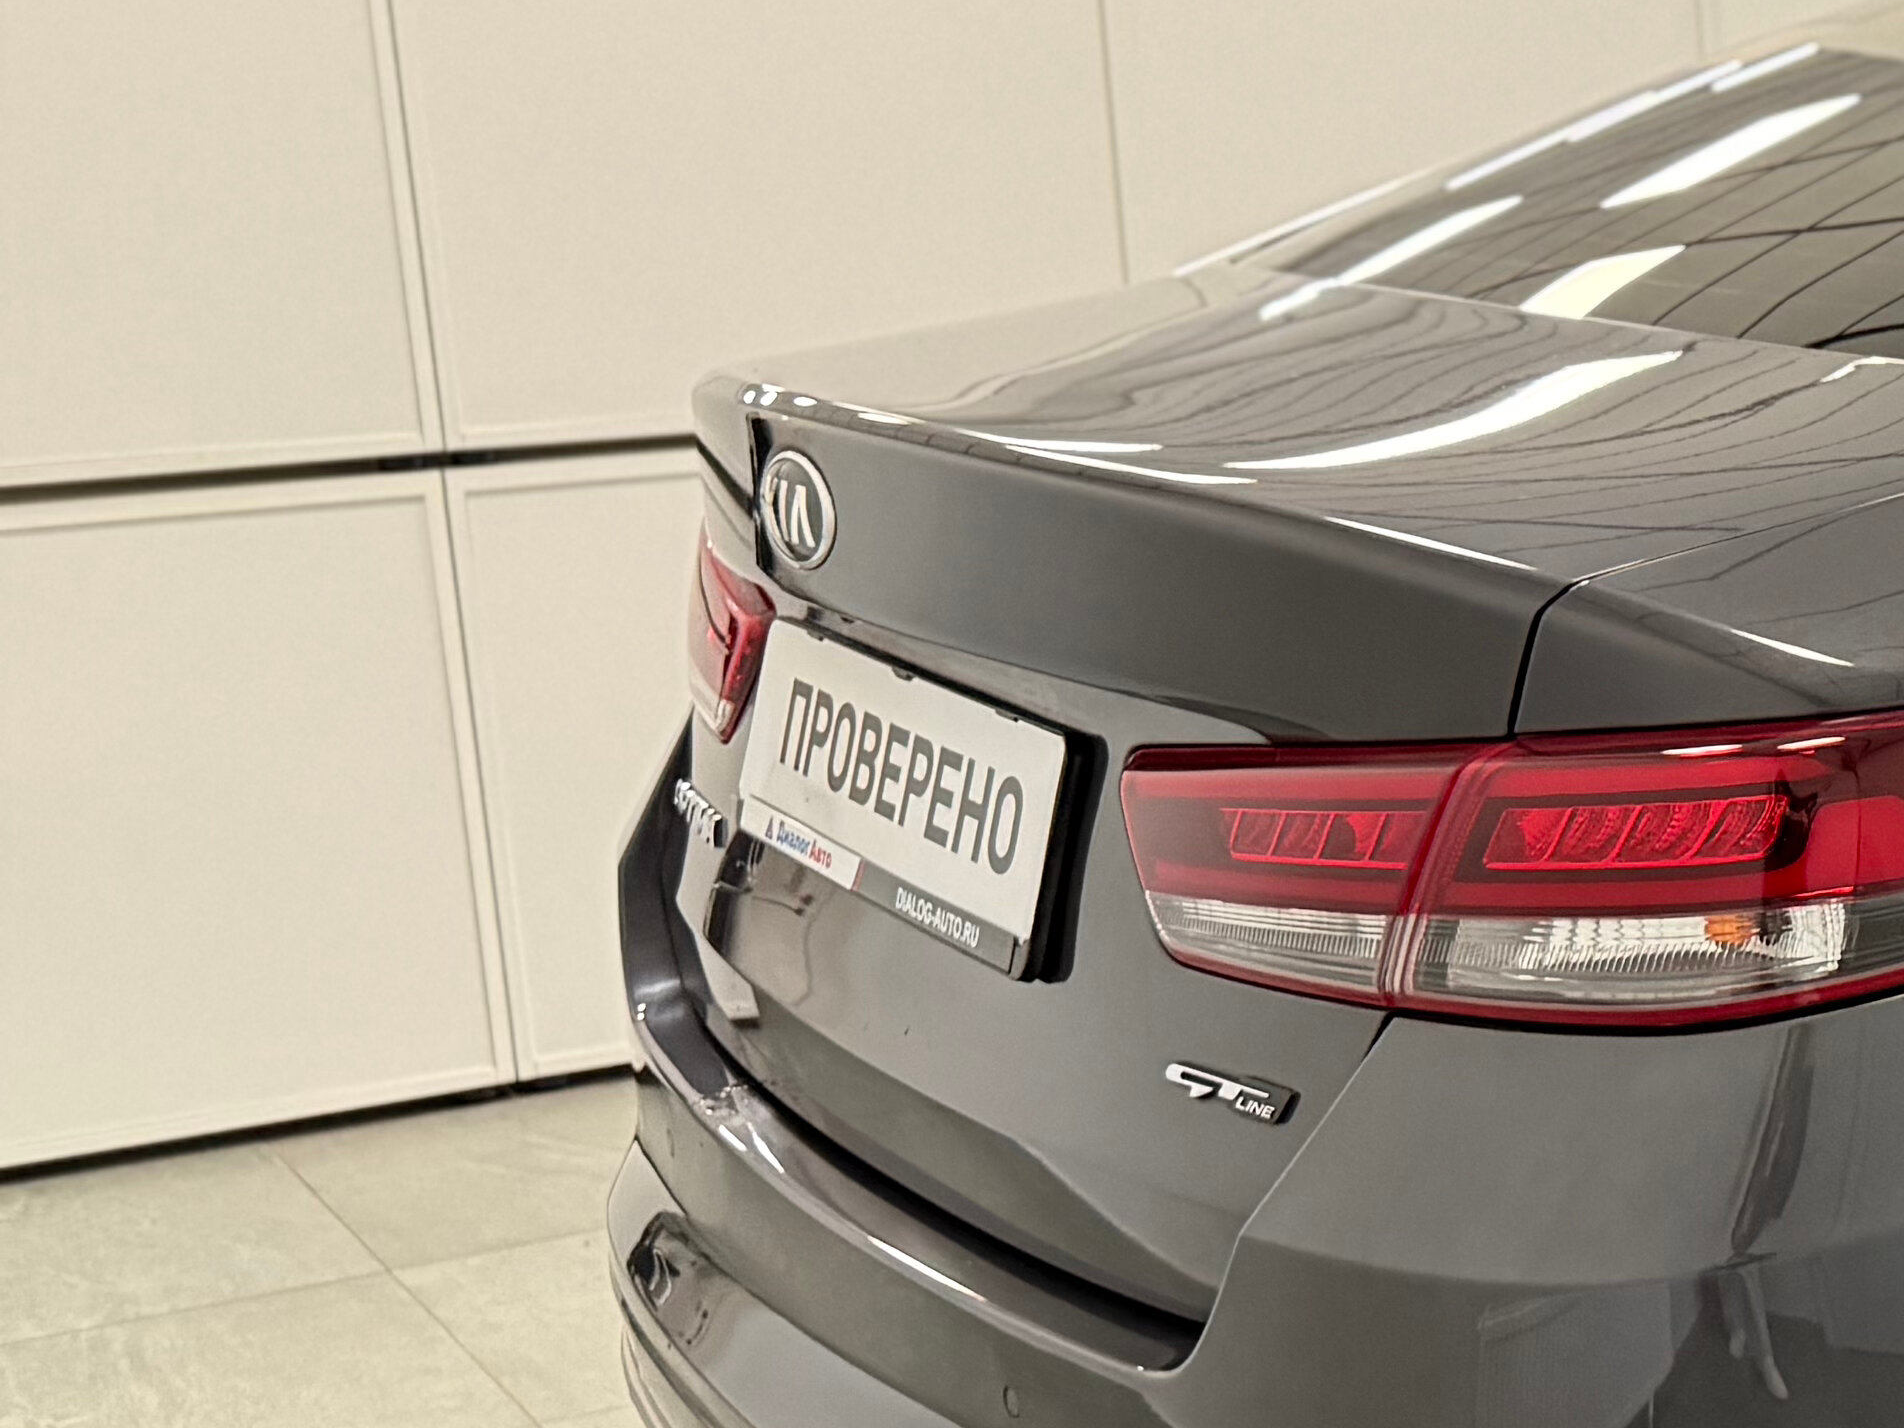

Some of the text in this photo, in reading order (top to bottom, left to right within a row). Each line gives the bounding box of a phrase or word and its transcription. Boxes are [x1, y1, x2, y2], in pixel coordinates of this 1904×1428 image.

[779, 676, 1024, 875] ПРОВЕРЕНО
[895, 886, 980, 948] DIALOG-AUTO.RU
[1235, 1095, 1276, 1120] LINE
